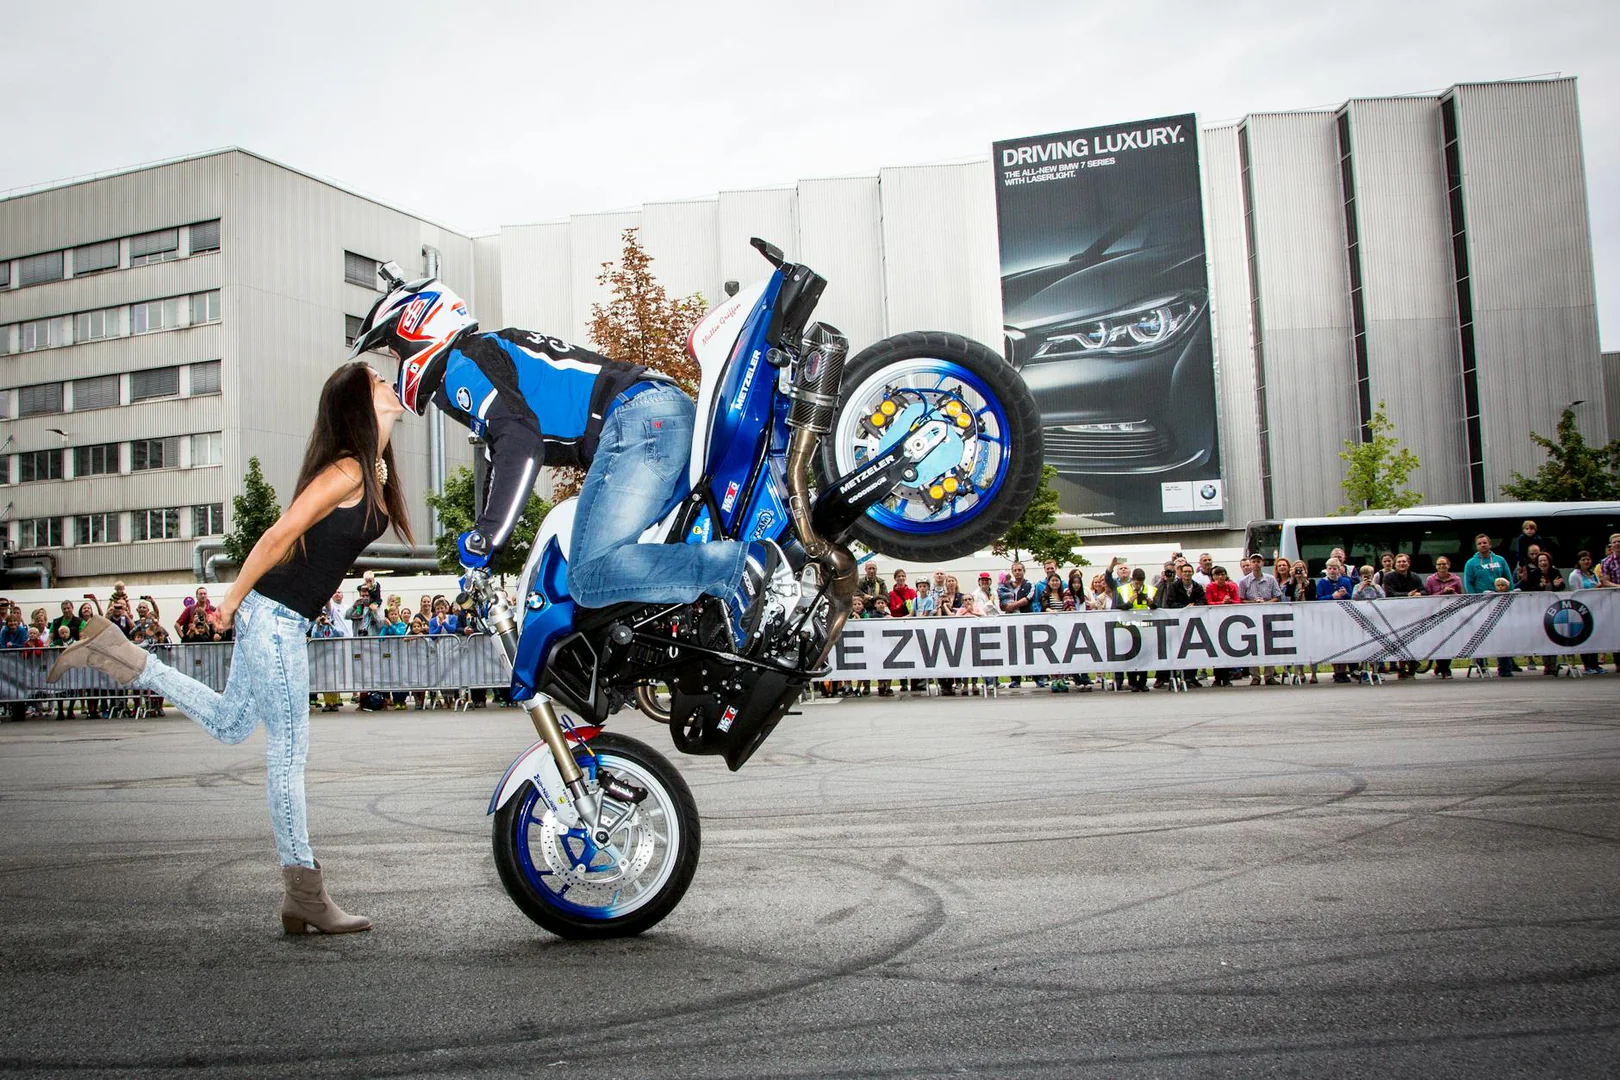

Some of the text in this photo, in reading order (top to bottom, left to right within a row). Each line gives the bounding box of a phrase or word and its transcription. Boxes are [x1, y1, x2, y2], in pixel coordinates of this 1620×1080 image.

[1002, 125, 1185, 167] DRIVING LUXURY.
[1004, 157, 1116, 179] THE ALL-NEW BMW 7 SERIES
[1004, 170, 1076, 186] WITH LASERLIGHT.
[734, 349, 762, 410] METZELER
[839, 454, 897, 494] METZELER
[882, 613, 1297, 669] ZWEIRADTAGE
